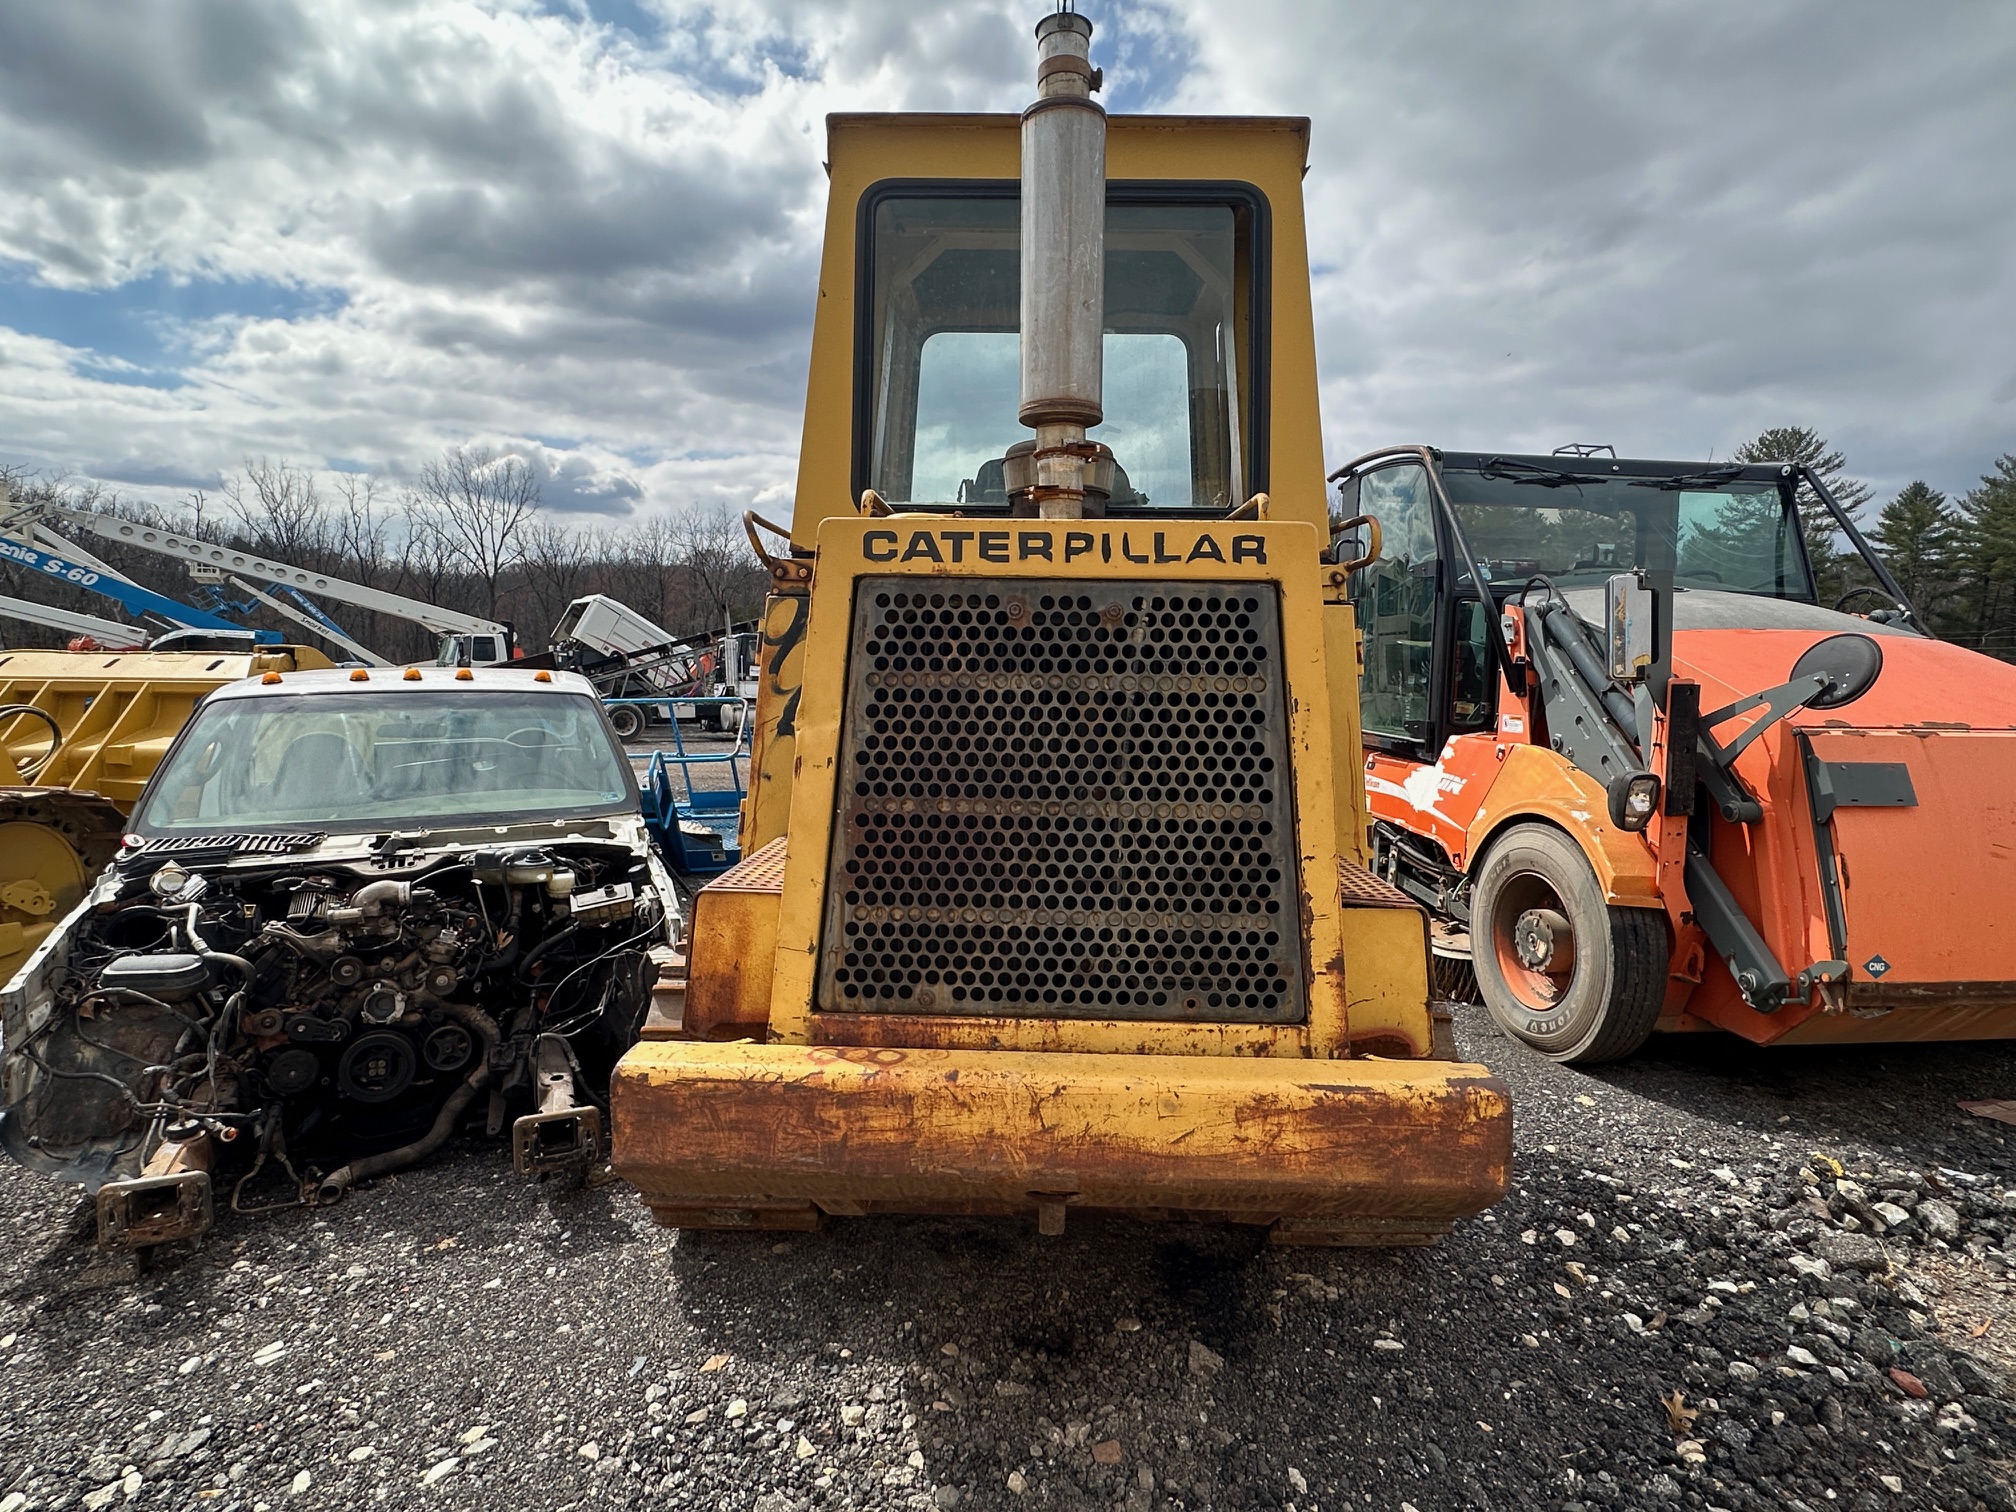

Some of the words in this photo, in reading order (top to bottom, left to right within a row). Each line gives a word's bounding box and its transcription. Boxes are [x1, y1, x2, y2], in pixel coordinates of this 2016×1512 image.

[862, 531, 1267, 564] CATERPILLAR
[43, 559, 99, 586] S-60
[1868, 961, 1885, 971] CNG
